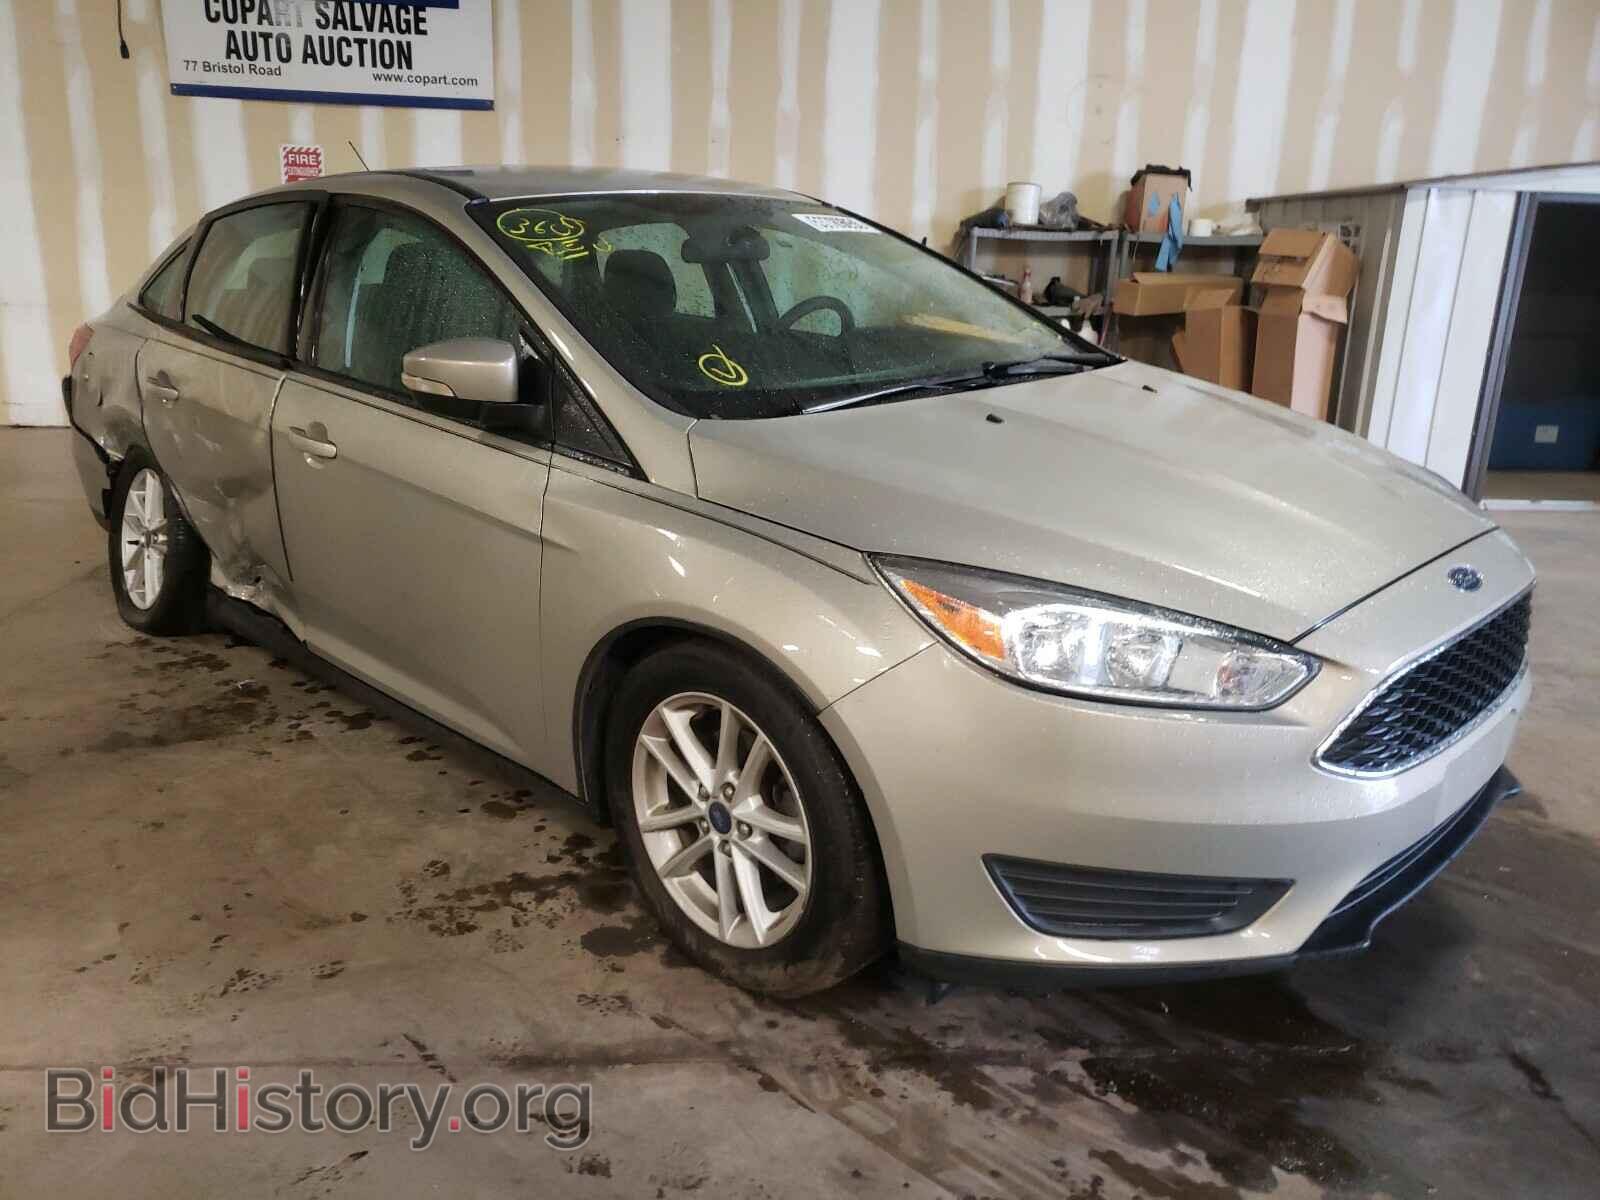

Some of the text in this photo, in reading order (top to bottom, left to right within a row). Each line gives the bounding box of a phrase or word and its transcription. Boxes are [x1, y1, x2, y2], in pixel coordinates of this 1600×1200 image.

[314, 0, 428, 36] SALVAGE
[225, 30, 413, 70] AUTO AUCTION
[183, 60, 282, 77] 77 Bristol Road
[372, 72, 478, 87] www.copart.com
[288, 153, 318, 166] FIRE
